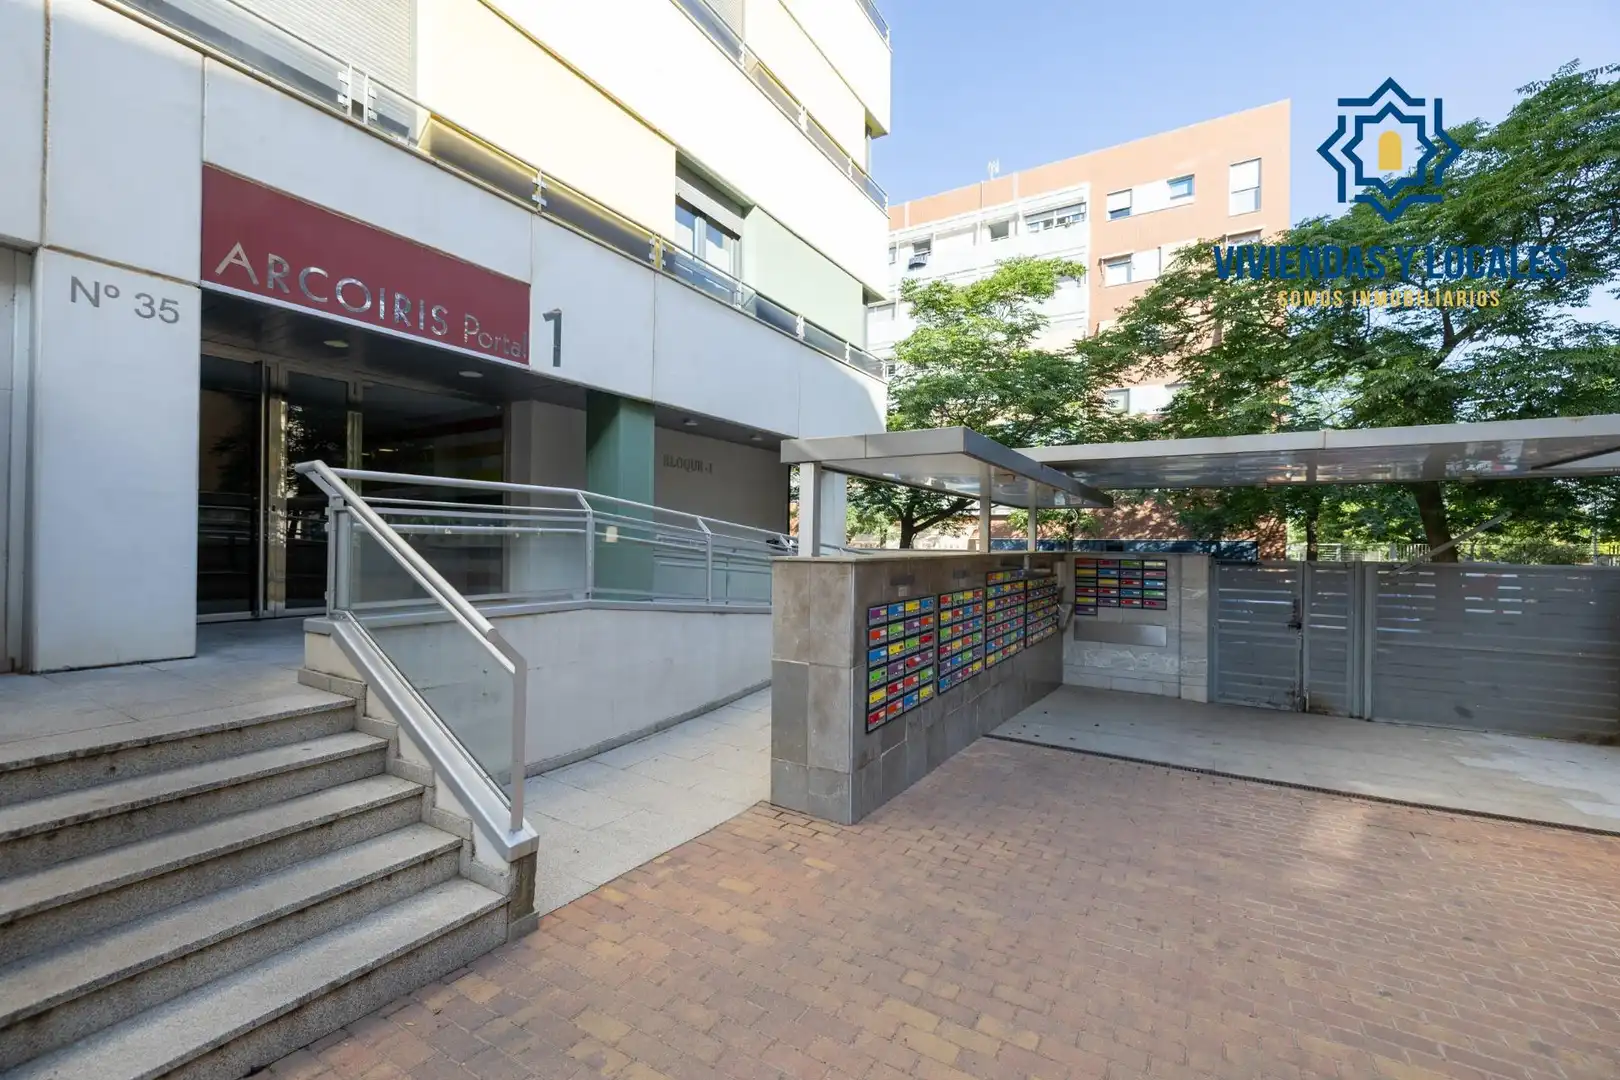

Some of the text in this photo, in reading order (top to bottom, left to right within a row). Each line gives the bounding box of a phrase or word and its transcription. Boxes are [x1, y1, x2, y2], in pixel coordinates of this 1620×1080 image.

[134, 291, 180, 324] 35
[214, 241, 562, 367] ARCOIRIS Portal 1
